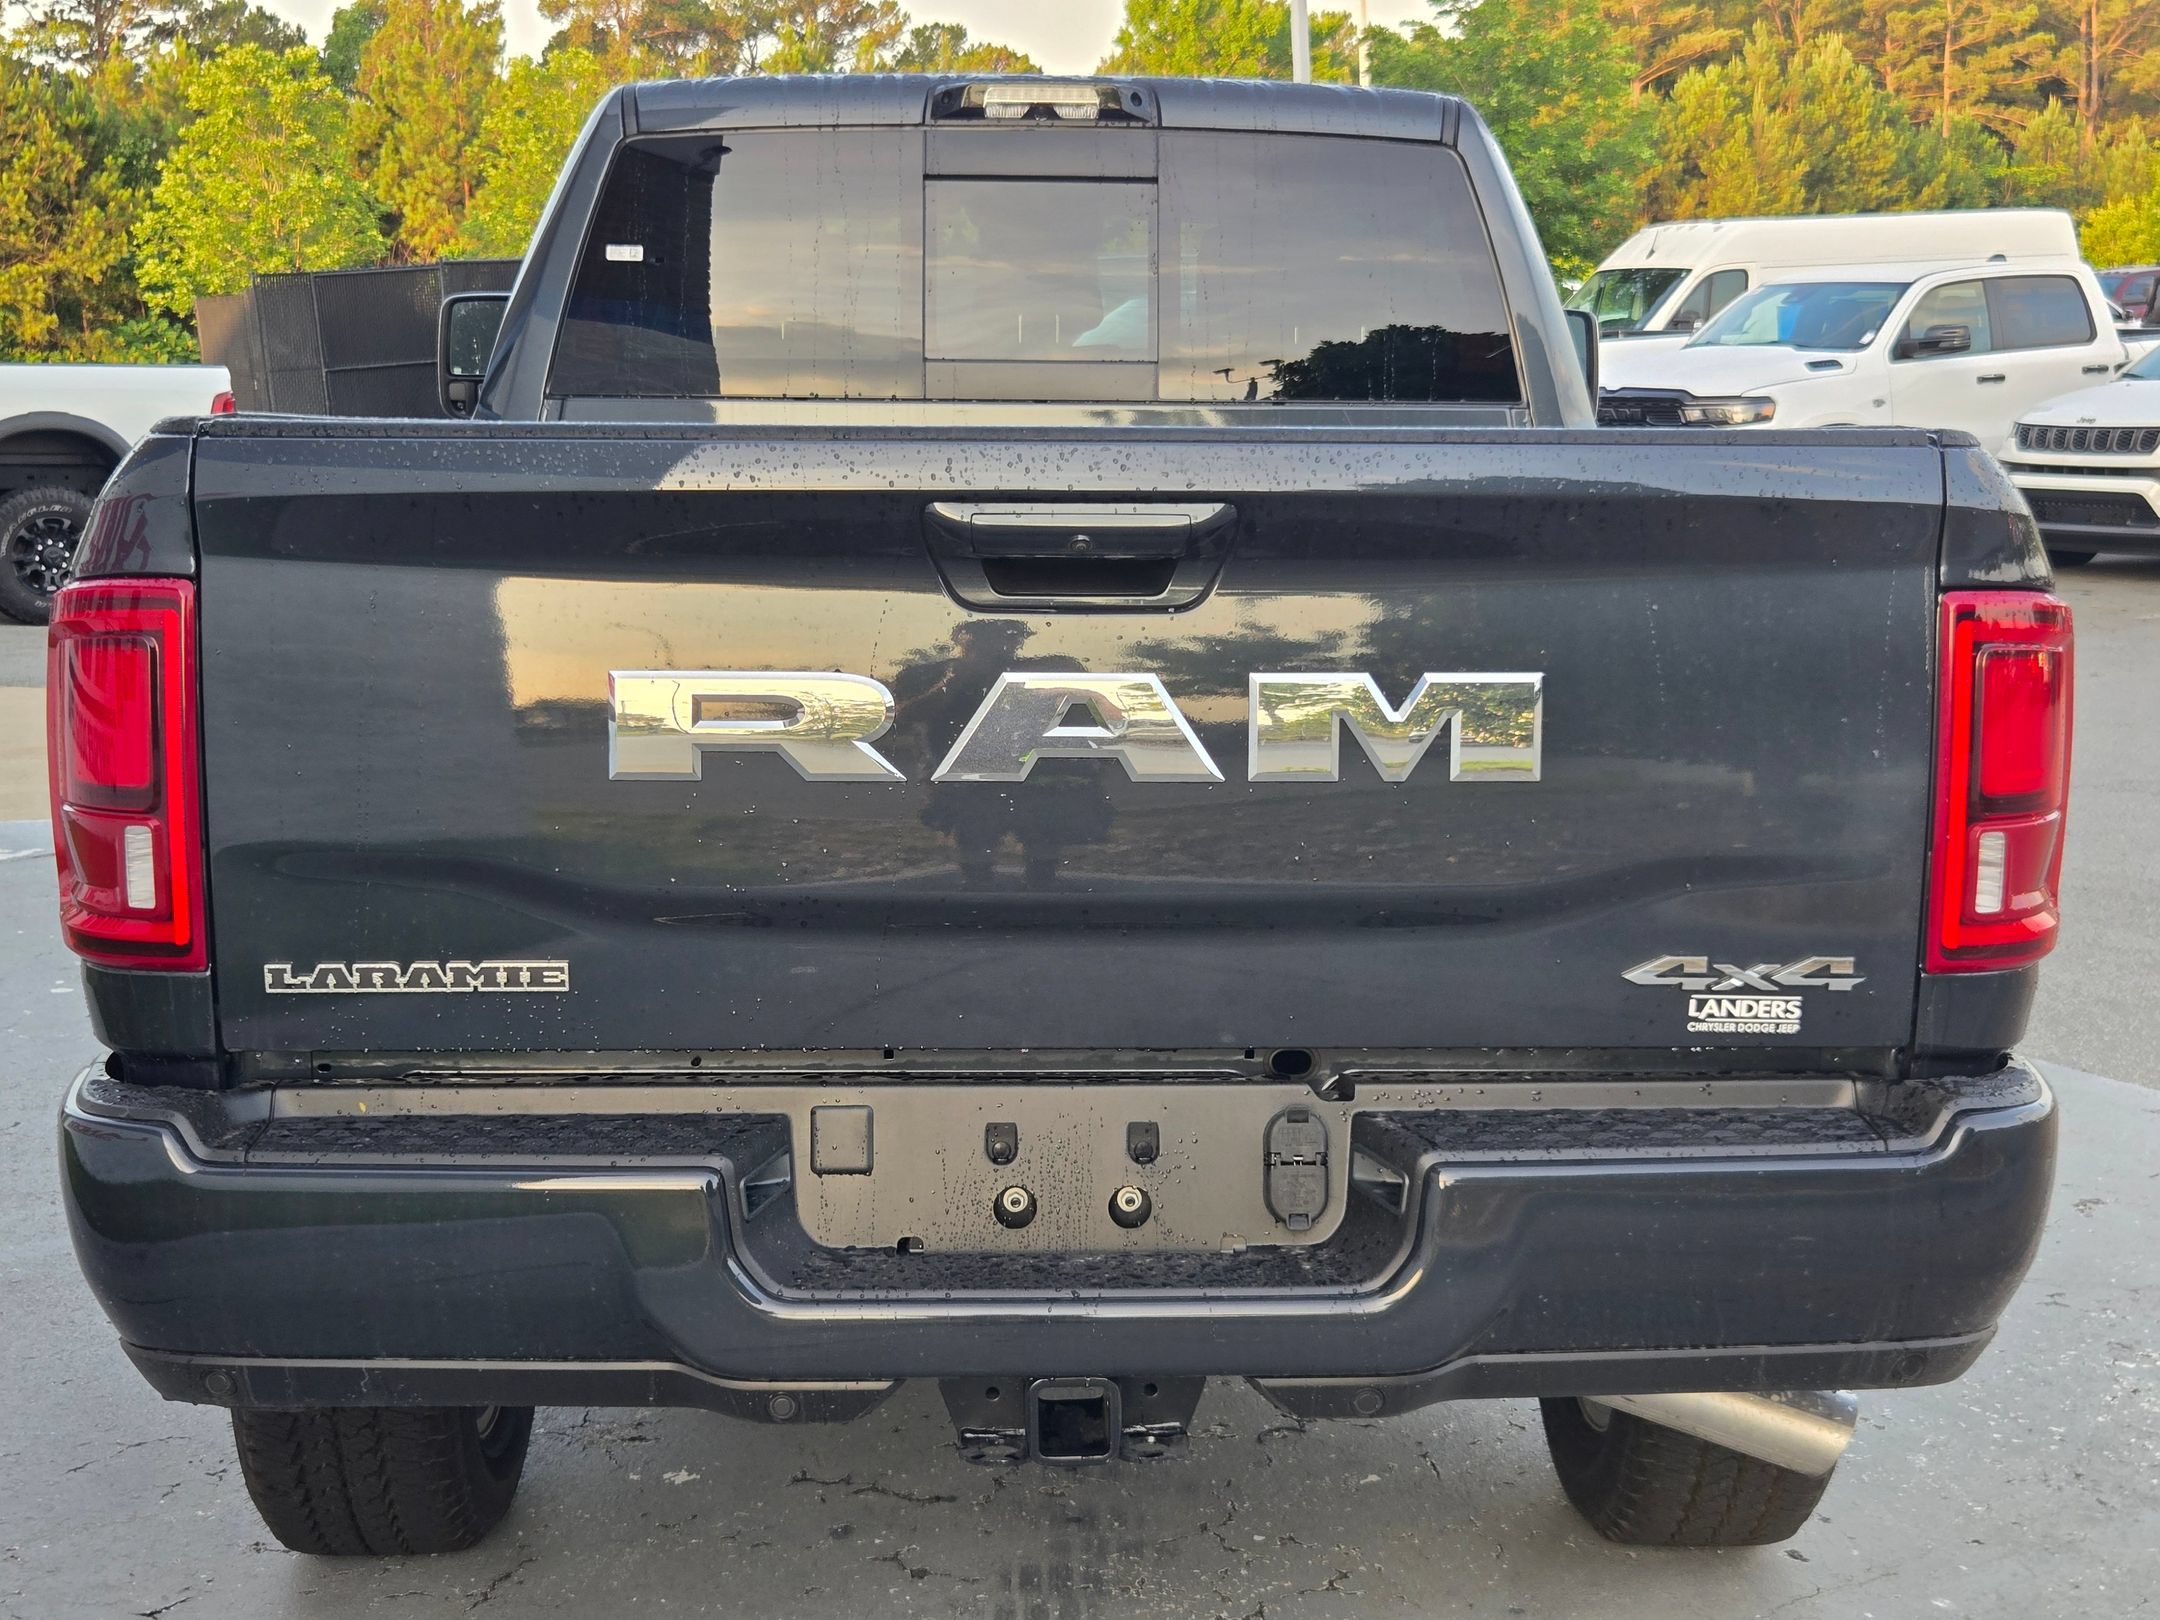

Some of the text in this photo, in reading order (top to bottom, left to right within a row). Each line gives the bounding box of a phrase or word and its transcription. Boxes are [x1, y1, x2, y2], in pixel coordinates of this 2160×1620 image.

[609, 671, 1544, 782] RAM
[263, 960, 570, 993] LARAMIE
[1621, 955, 1867, 991] 4x4
[1688, 998, 1803, 1019] LANDERS
[1687, 1021, 1801, 1034] CHRYSLER DODGE JEEP
